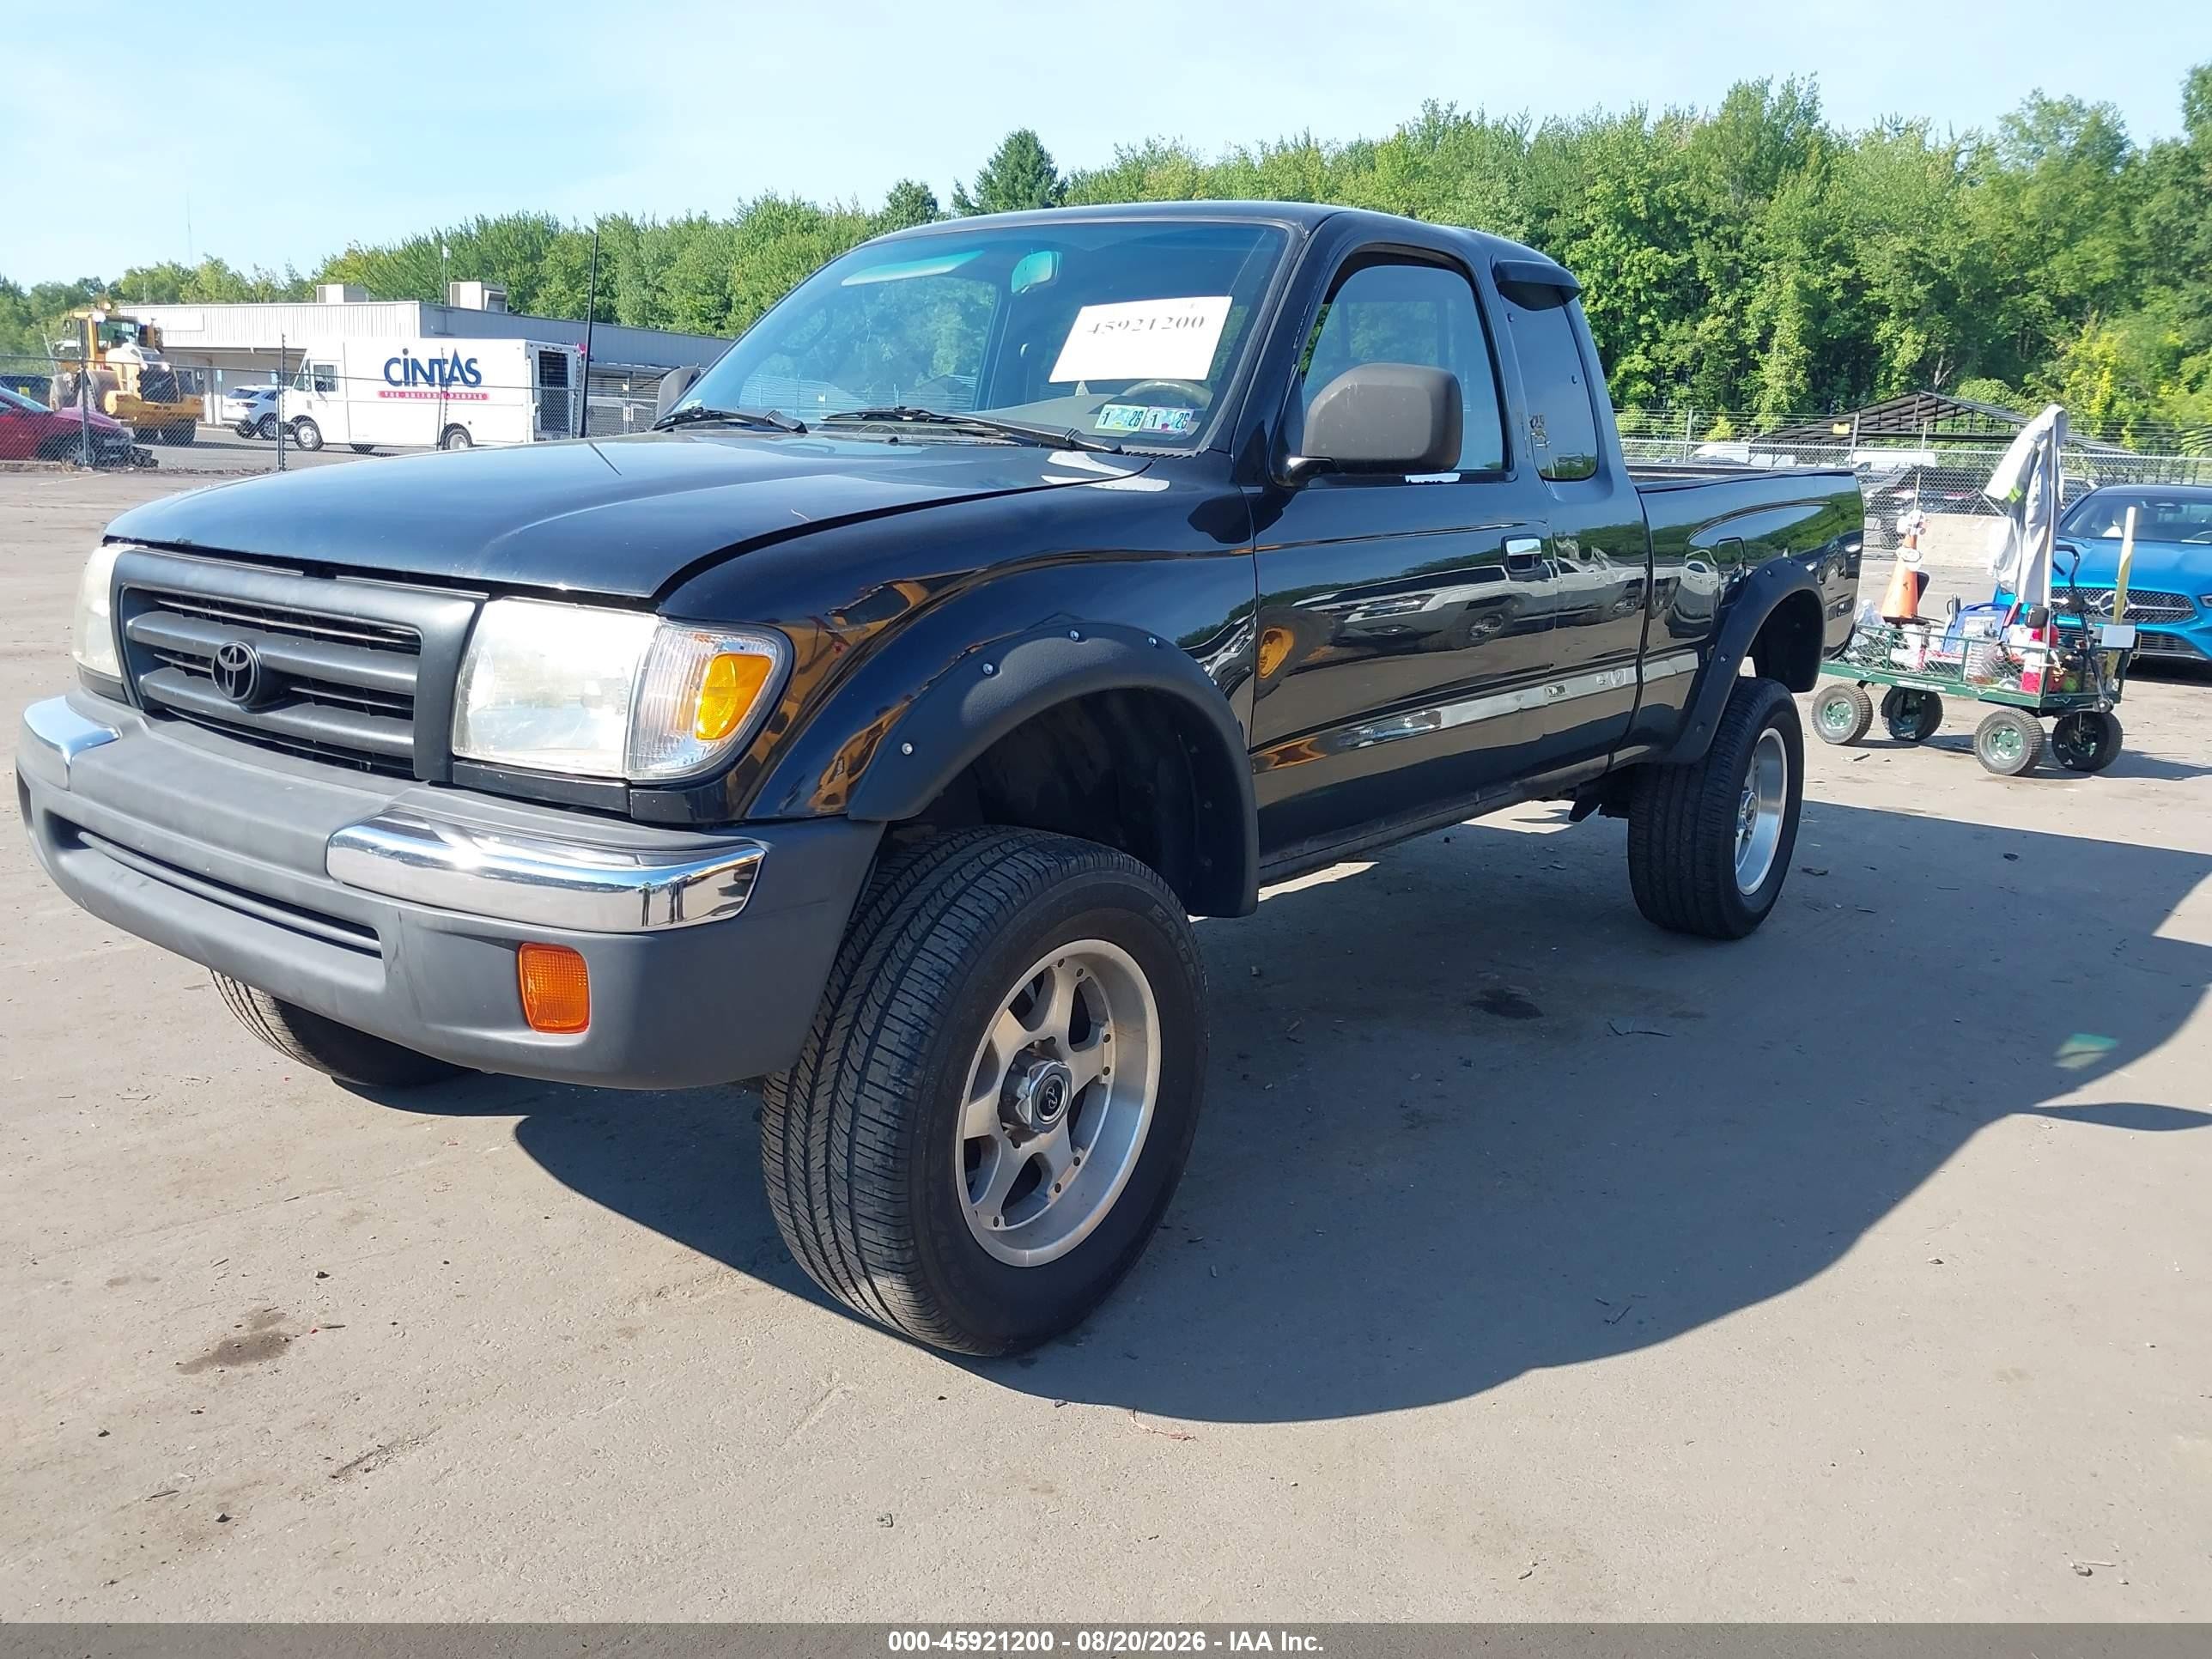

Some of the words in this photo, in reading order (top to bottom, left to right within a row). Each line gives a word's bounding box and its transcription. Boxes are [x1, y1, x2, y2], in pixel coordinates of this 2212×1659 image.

[1087, 315, 1205, 334] 45921200
[1103, 412, 1110, 426] 1
[1152, 414, 1158, 428] 1
